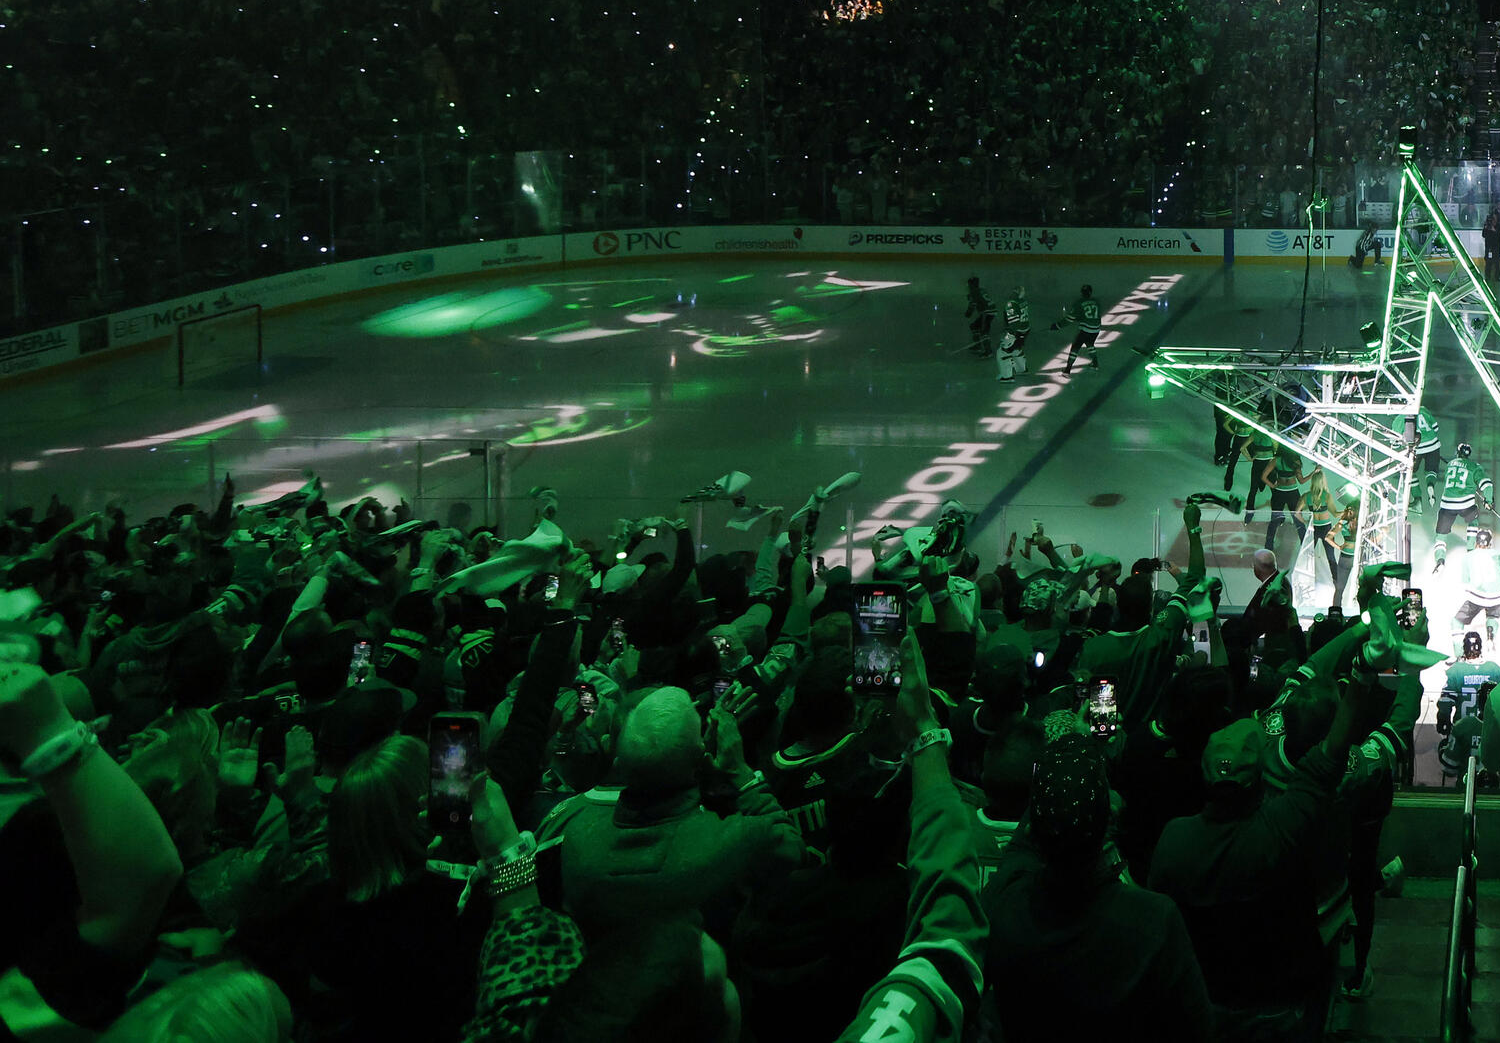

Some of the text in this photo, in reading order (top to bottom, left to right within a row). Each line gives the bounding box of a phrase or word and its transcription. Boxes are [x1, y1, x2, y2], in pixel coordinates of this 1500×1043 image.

[625, 230, 682, 251] PNC
[865, 232, 944, 246] PRIZEPICKS
[984, 229, 1033, 238] BEST IN
[984, 239, 1033, 252] TEXAS
[1116, 235, 1181, 250] American
[1292, 235, 1335, 250] AT&T
[1101, 273, 1185, 326] TEXAS
[114, 301, 205, 340] BETMGM
[1444, 466, 1469, 490] 23
